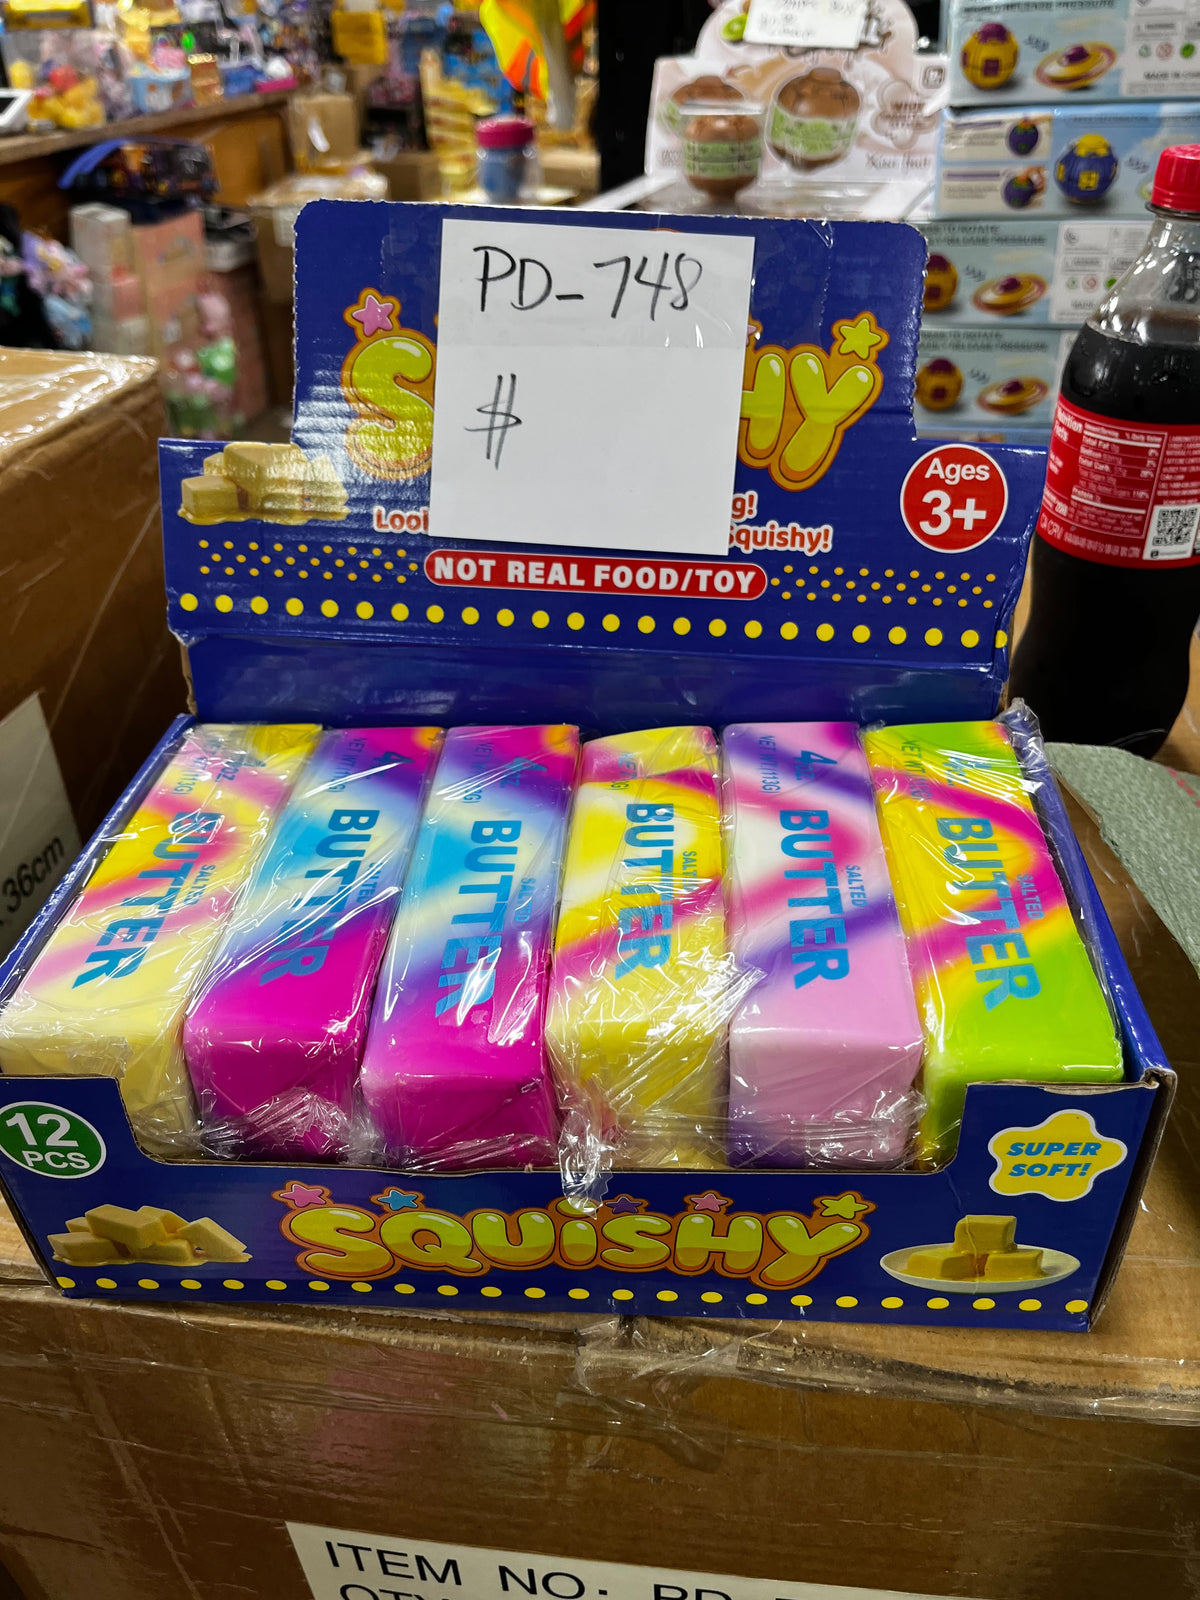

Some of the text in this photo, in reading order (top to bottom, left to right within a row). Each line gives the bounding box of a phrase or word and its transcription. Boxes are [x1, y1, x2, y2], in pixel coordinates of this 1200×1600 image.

[924, 457, 990, 486] Ages
[919, 489, 987, 536] 3+
[434, 557, 757, 595] NOT REAL FOOD/TOY
[3, 836, 65, 913] 36cm
[259, 809, 380, 987] BUTTER
[615, 803, 675, 981] BUTTER
[845, 864, 868, 908] SALTED
[1017, 873, 1045, 920] SALTED
[72, 811, 224, 990] BUTTER
[434, 820, 522, 1019] BUTTER
[779, 809, 850, 990] BUTTER
[936, 817, 1042, 1013] BUTTER
[5, 1112, 79, 1147] 12
[1006, 1142, 1102, 1157] SUPER
[21, 1150, 91, 1170] PCS
[1008, 1163, 1092, 1178] SOFT!
[325, 1541, 608, 1600] ITEM NO.
